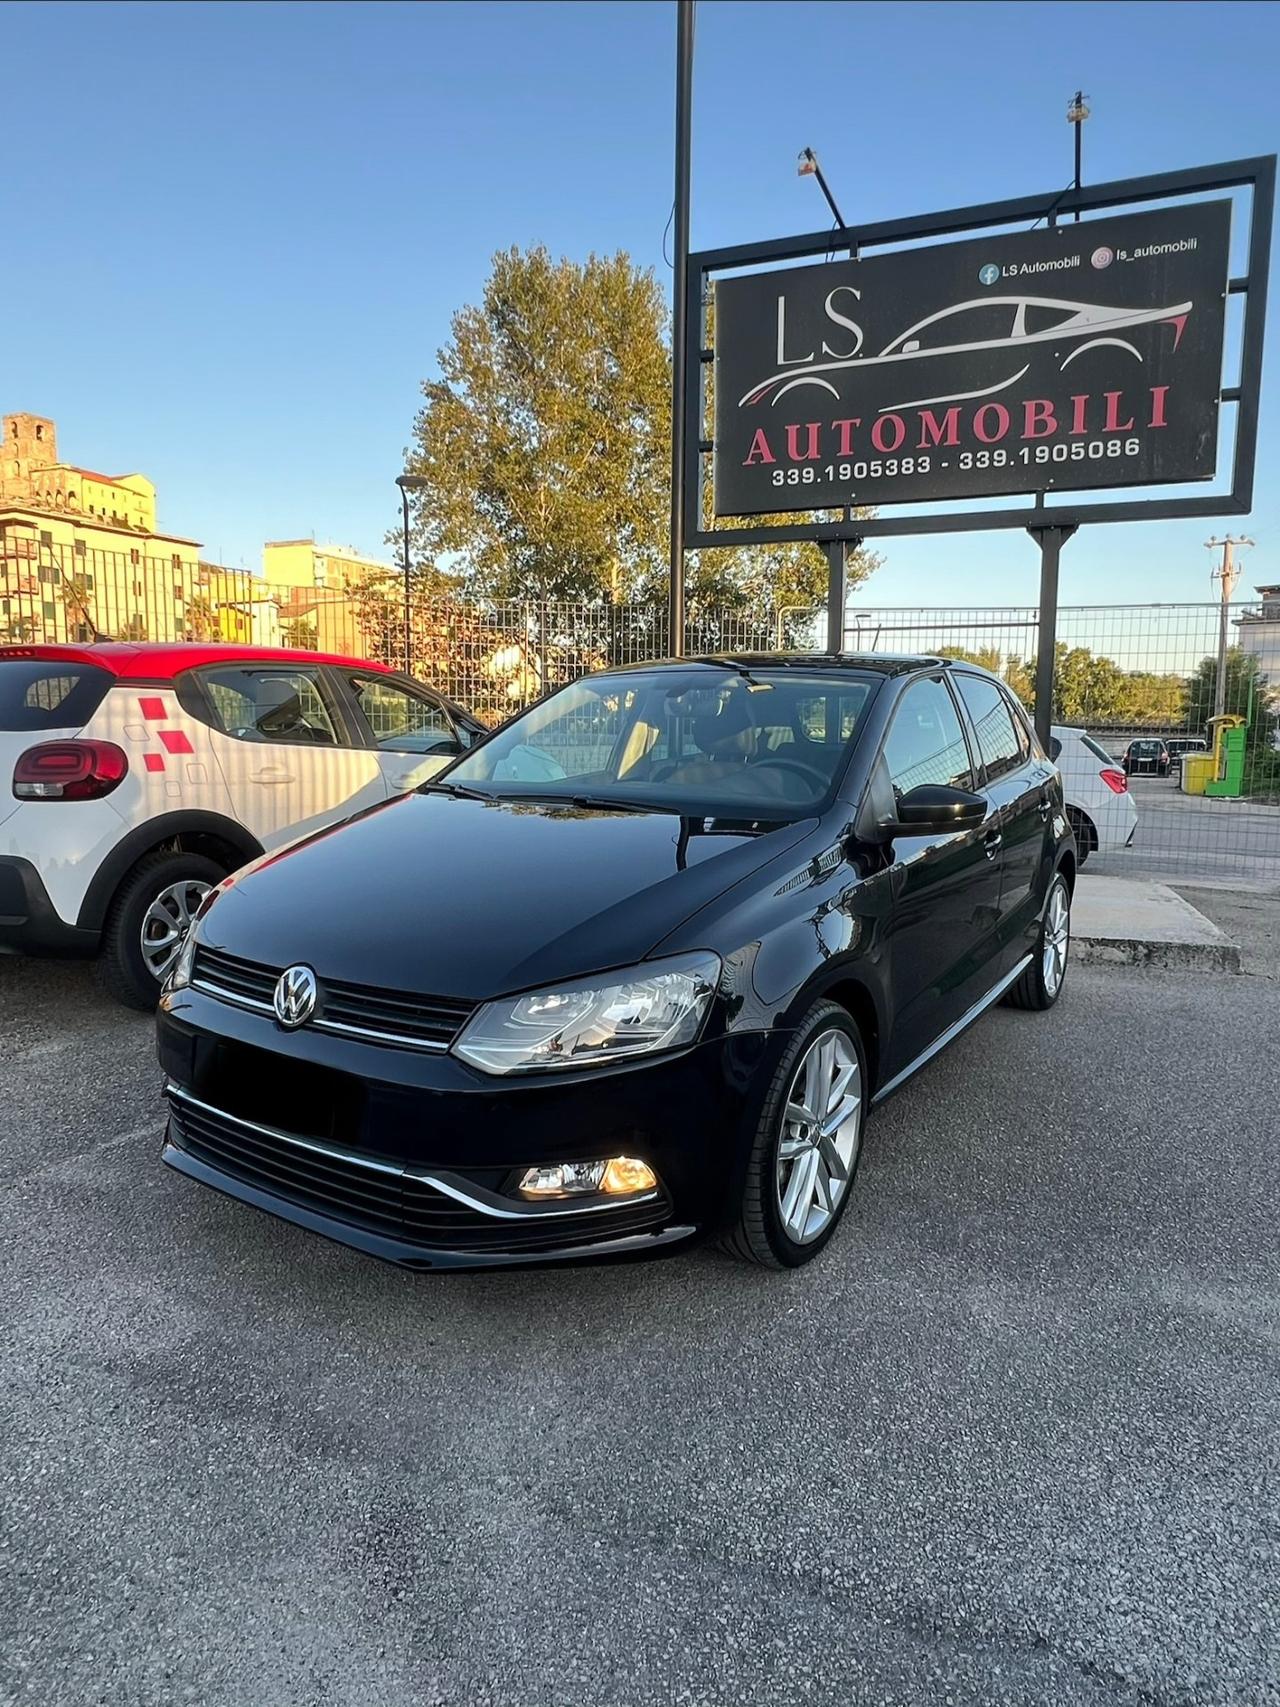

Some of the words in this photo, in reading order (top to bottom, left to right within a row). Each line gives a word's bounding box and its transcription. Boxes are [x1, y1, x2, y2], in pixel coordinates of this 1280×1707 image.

[1001, 264, 1018, 278] LS
[1020, 255, 1081, 275] Automobili
[1116, 238, 1198, 262] ls_automobili
[742, 385, 1170, 466] AUTOMOBILI
[772, 456, 931, 486] 339.1905383
[959, 438, 1140, 470] 339.1905086
